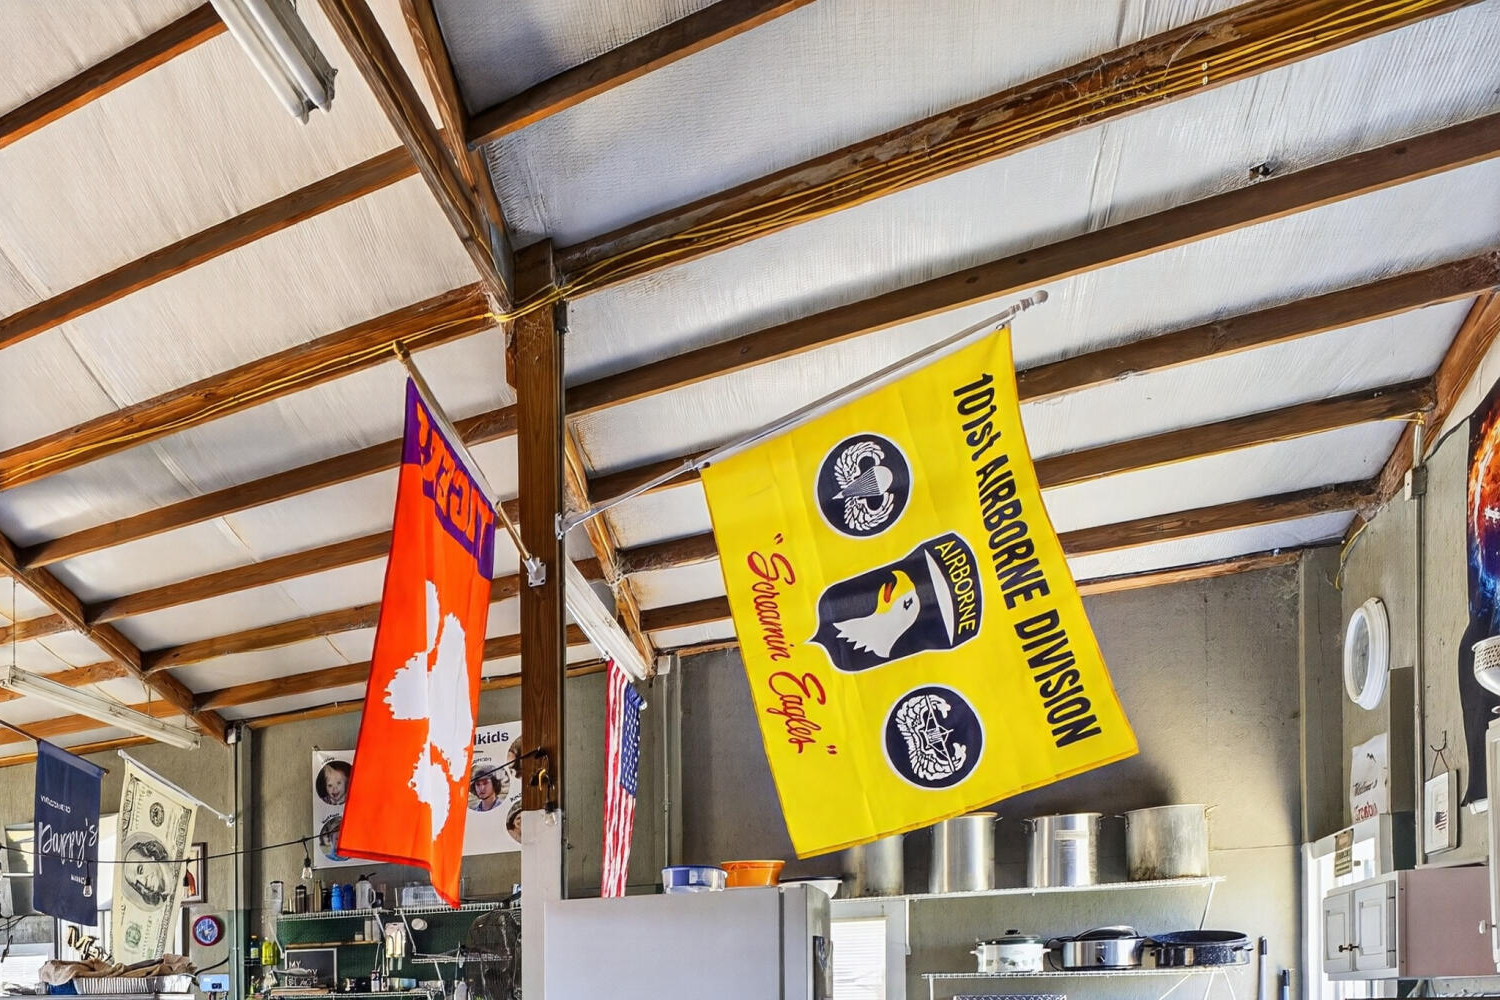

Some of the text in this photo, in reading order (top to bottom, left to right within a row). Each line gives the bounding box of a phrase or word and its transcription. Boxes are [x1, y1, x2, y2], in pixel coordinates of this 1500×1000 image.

[934, 540, 977, 635] AIRBORNE
[953, 373, 1102, 748] 101st AIRBORNE DIVISION
